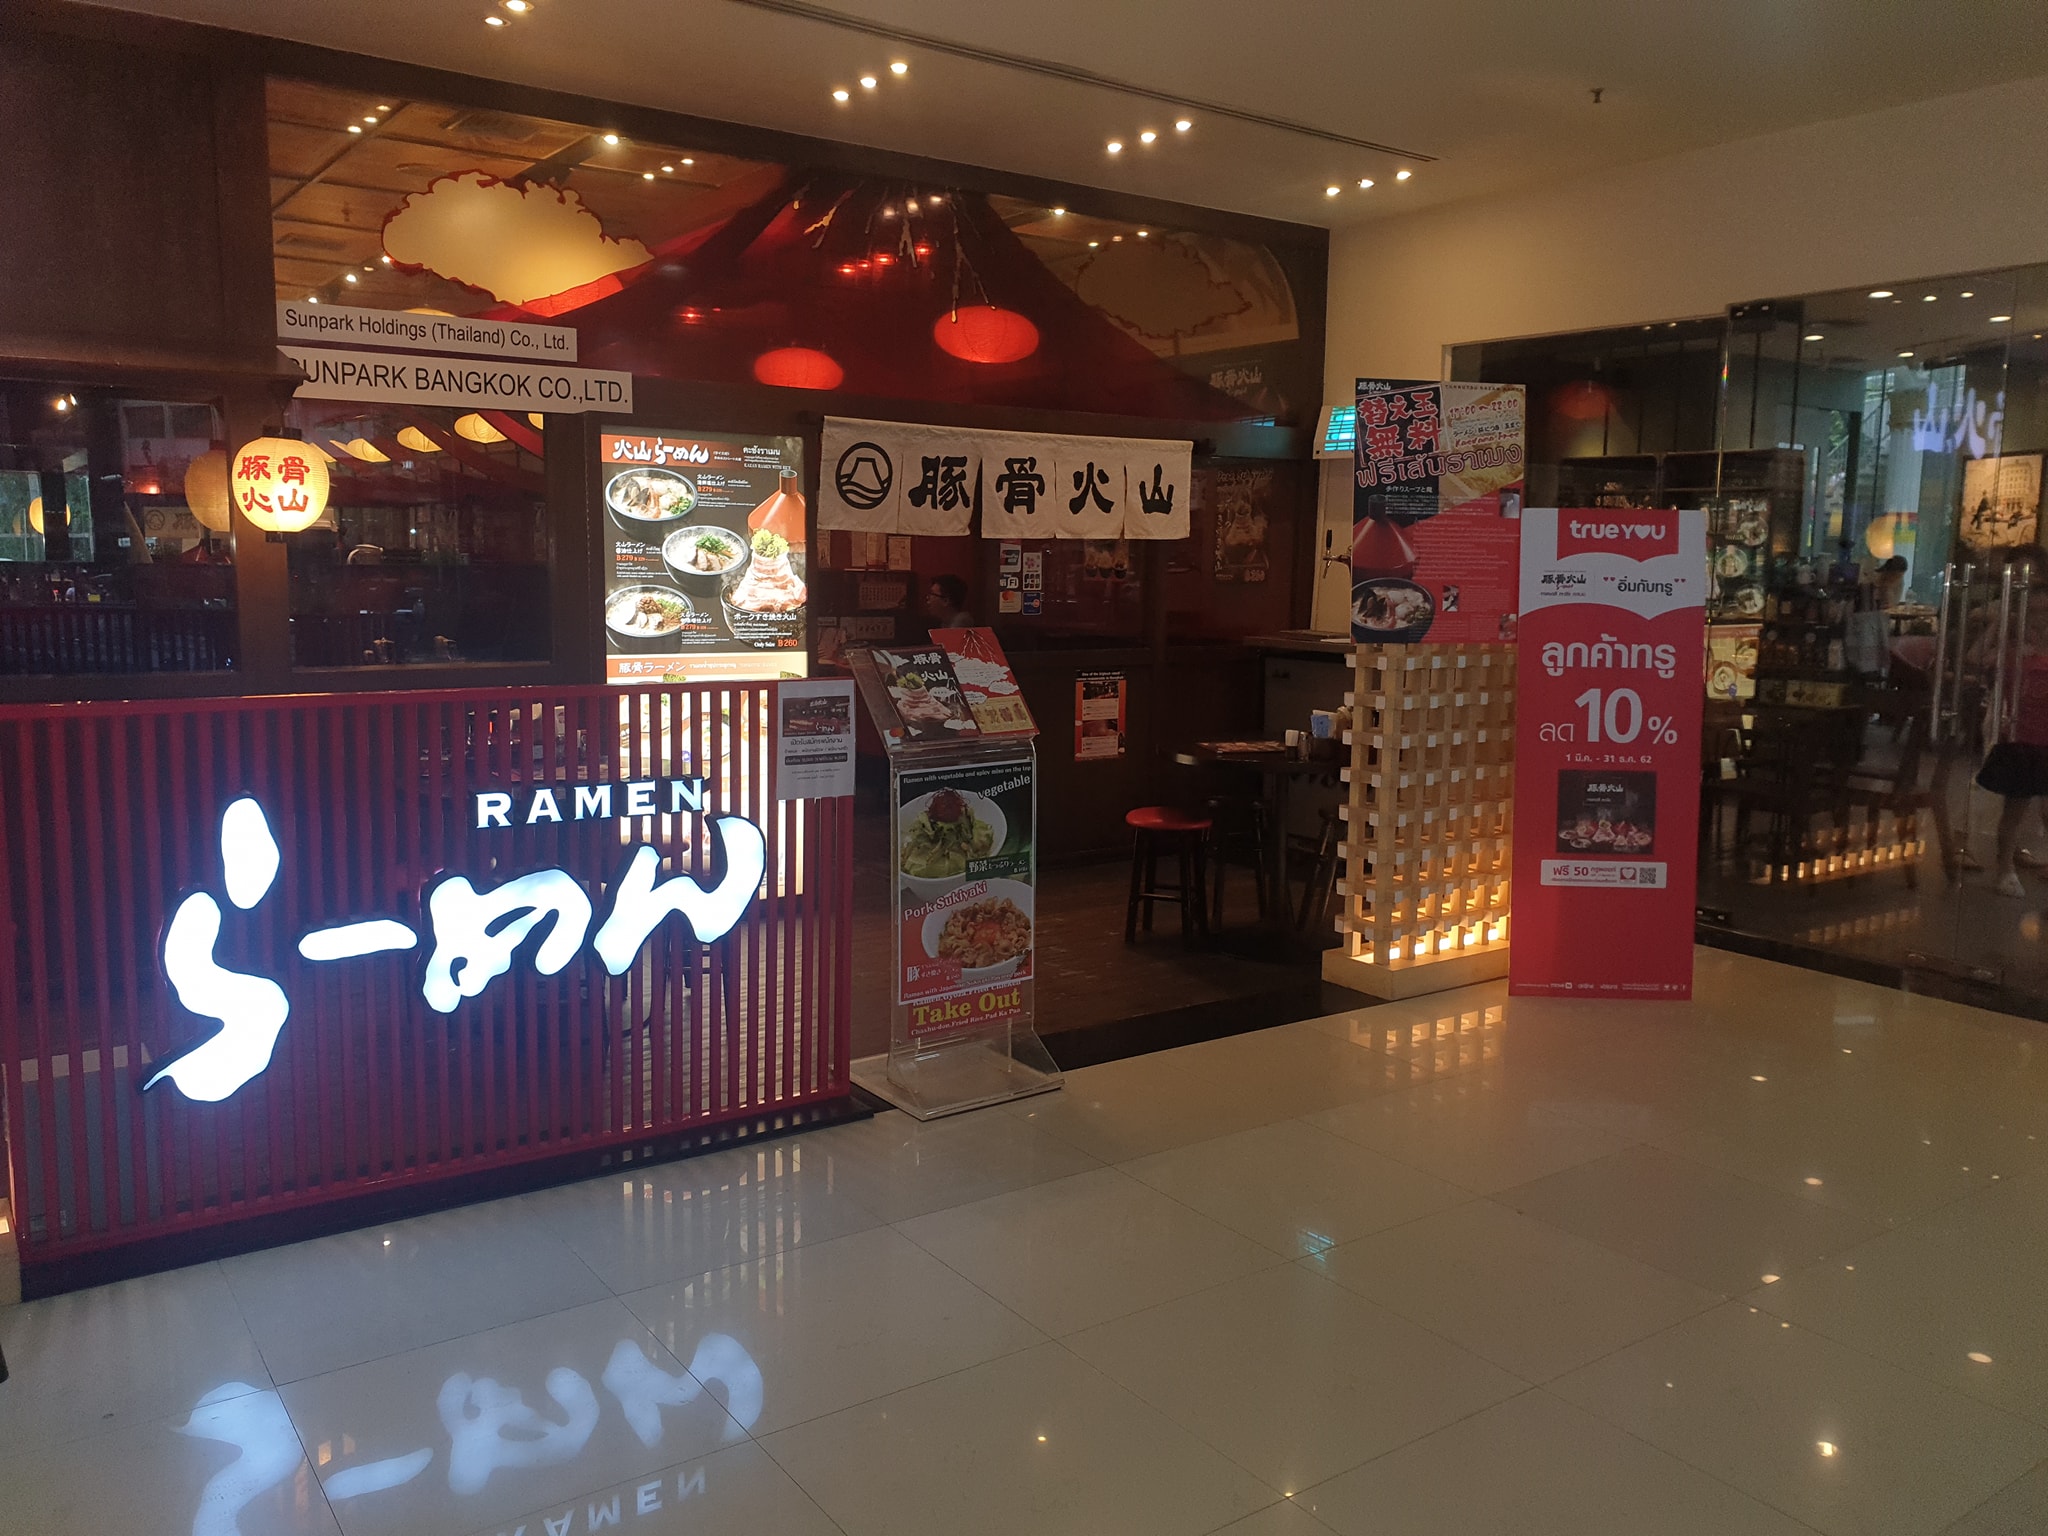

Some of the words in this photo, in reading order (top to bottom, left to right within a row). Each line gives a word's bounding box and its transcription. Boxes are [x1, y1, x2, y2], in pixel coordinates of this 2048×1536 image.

[285, 309, 355, 333] Sunpark
[359, 316, 427, 341] Holdings
[431, 322, 506, 349] (Thailand)
[510, 331, 539, 349] Co.,
[543, 334, 570, 350] Ltd.
[415, 368, 532, 398] BANGKOK
[538, 377, 629, 404] CO.,LTD.
[1357, 391, 1438, 425] 替え玉
[612, 436, 709, 465] 火山らーめん
[1366, 417, 1441, 461] 無料
[237, 455, 310, 485] 豚骨
[1356, 444, 1522, 488] ฟรีเส้นราเมง
[242, 486, 309, 514] 火山
[908, 455, 1174, 515] 豚骨火山
[619, 661, 686, 673] 豚骨ラーメン
[912, 652, 942, 665] 豚骨
[1541, 633, 1677, 679] ลูกค้าทรู
[921, 669, 948, 682] 火山
[1539, 722, 1575, 742] ลด
[1574, 688, 1643, 744] 10
[1647, 716, 1678, 744] %
[1566, 754, 1571, 762] 1
[1603, 755, 1615, 763] 31
[1640, 755, 1652, 763] 62
[937, 772, 965, 781] vegetable
[977, 774, 1031, 800] vegetable
[476, 778, 704, 829] RAMEN
[1553, 864, 1569, 876] ฟรี
[1574, 867, 1589, 876] 50
[903, 902, 934, 921] Pork
[937, 881, 988, 910] Sukiyaki
[144, 797, 767, 1103] らーめん
[913, 1001, 972, 1026] Take
[979, 988, 1020, 1012] Out
